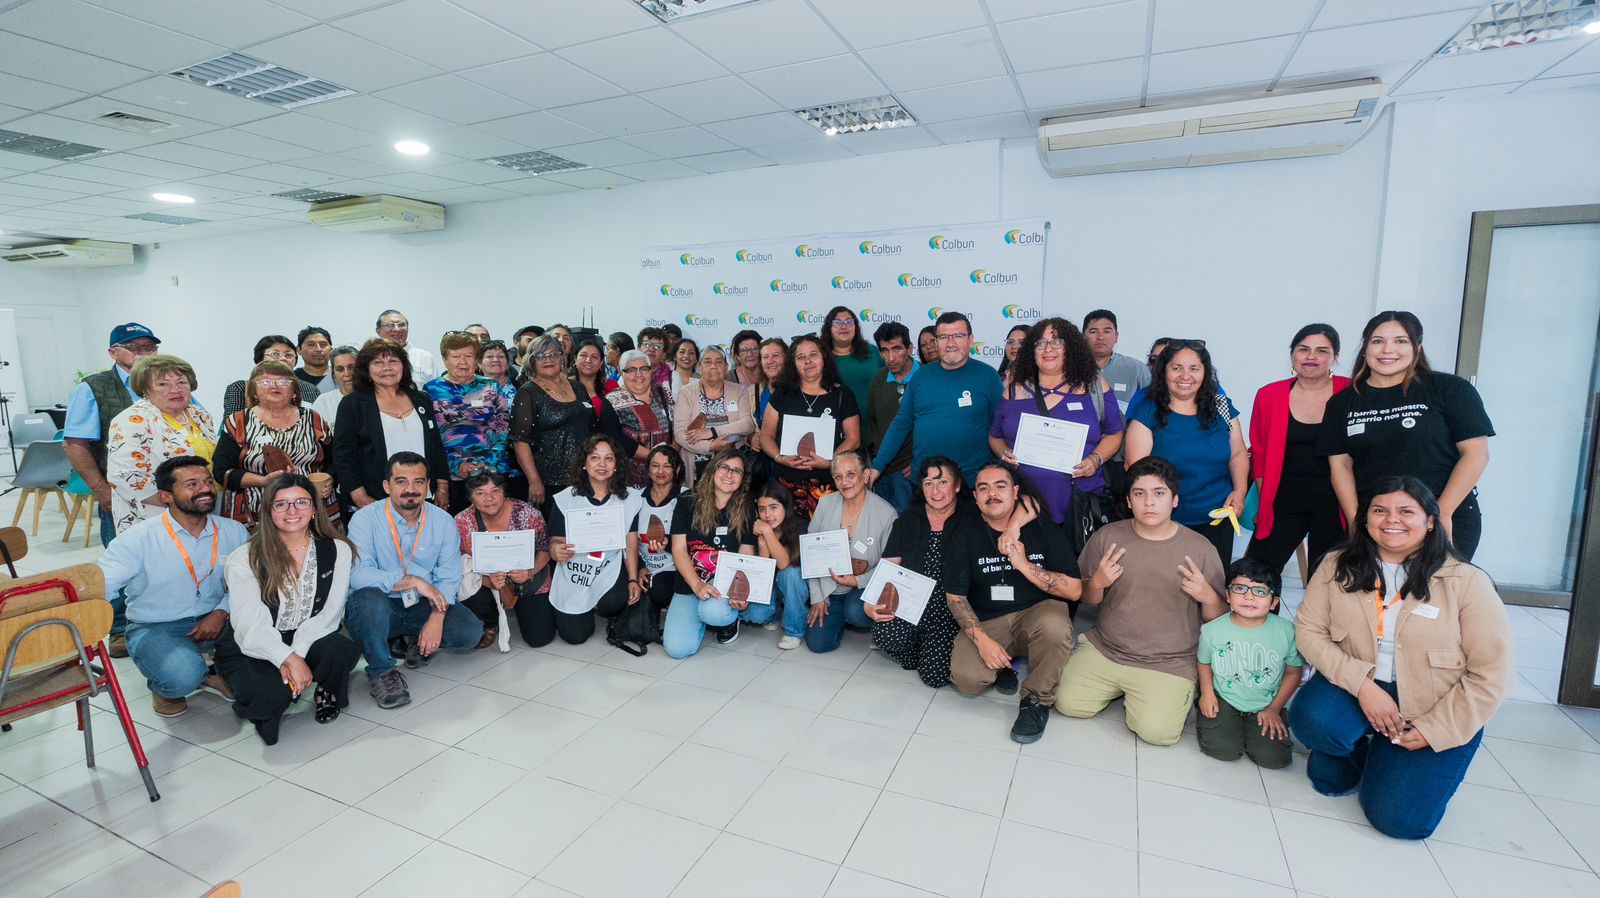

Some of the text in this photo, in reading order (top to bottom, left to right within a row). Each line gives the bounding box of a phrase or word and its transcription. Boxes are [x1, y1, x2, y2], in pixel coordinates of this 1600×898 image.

[1019, 232, 1044, 244] Colb
[641, 258, 661, 268] olbun
[1016, 308, 1041, 319] Colb
[645, 318, 666, 327] olbun
[1353, 409, 1378, 417] barrio
[1392, 404, 1428, 412] nuestro,
[978, 557, 985, 565] El
[567, 561, 593, 575] CRUZ
[982, 565, 990, 573] el
